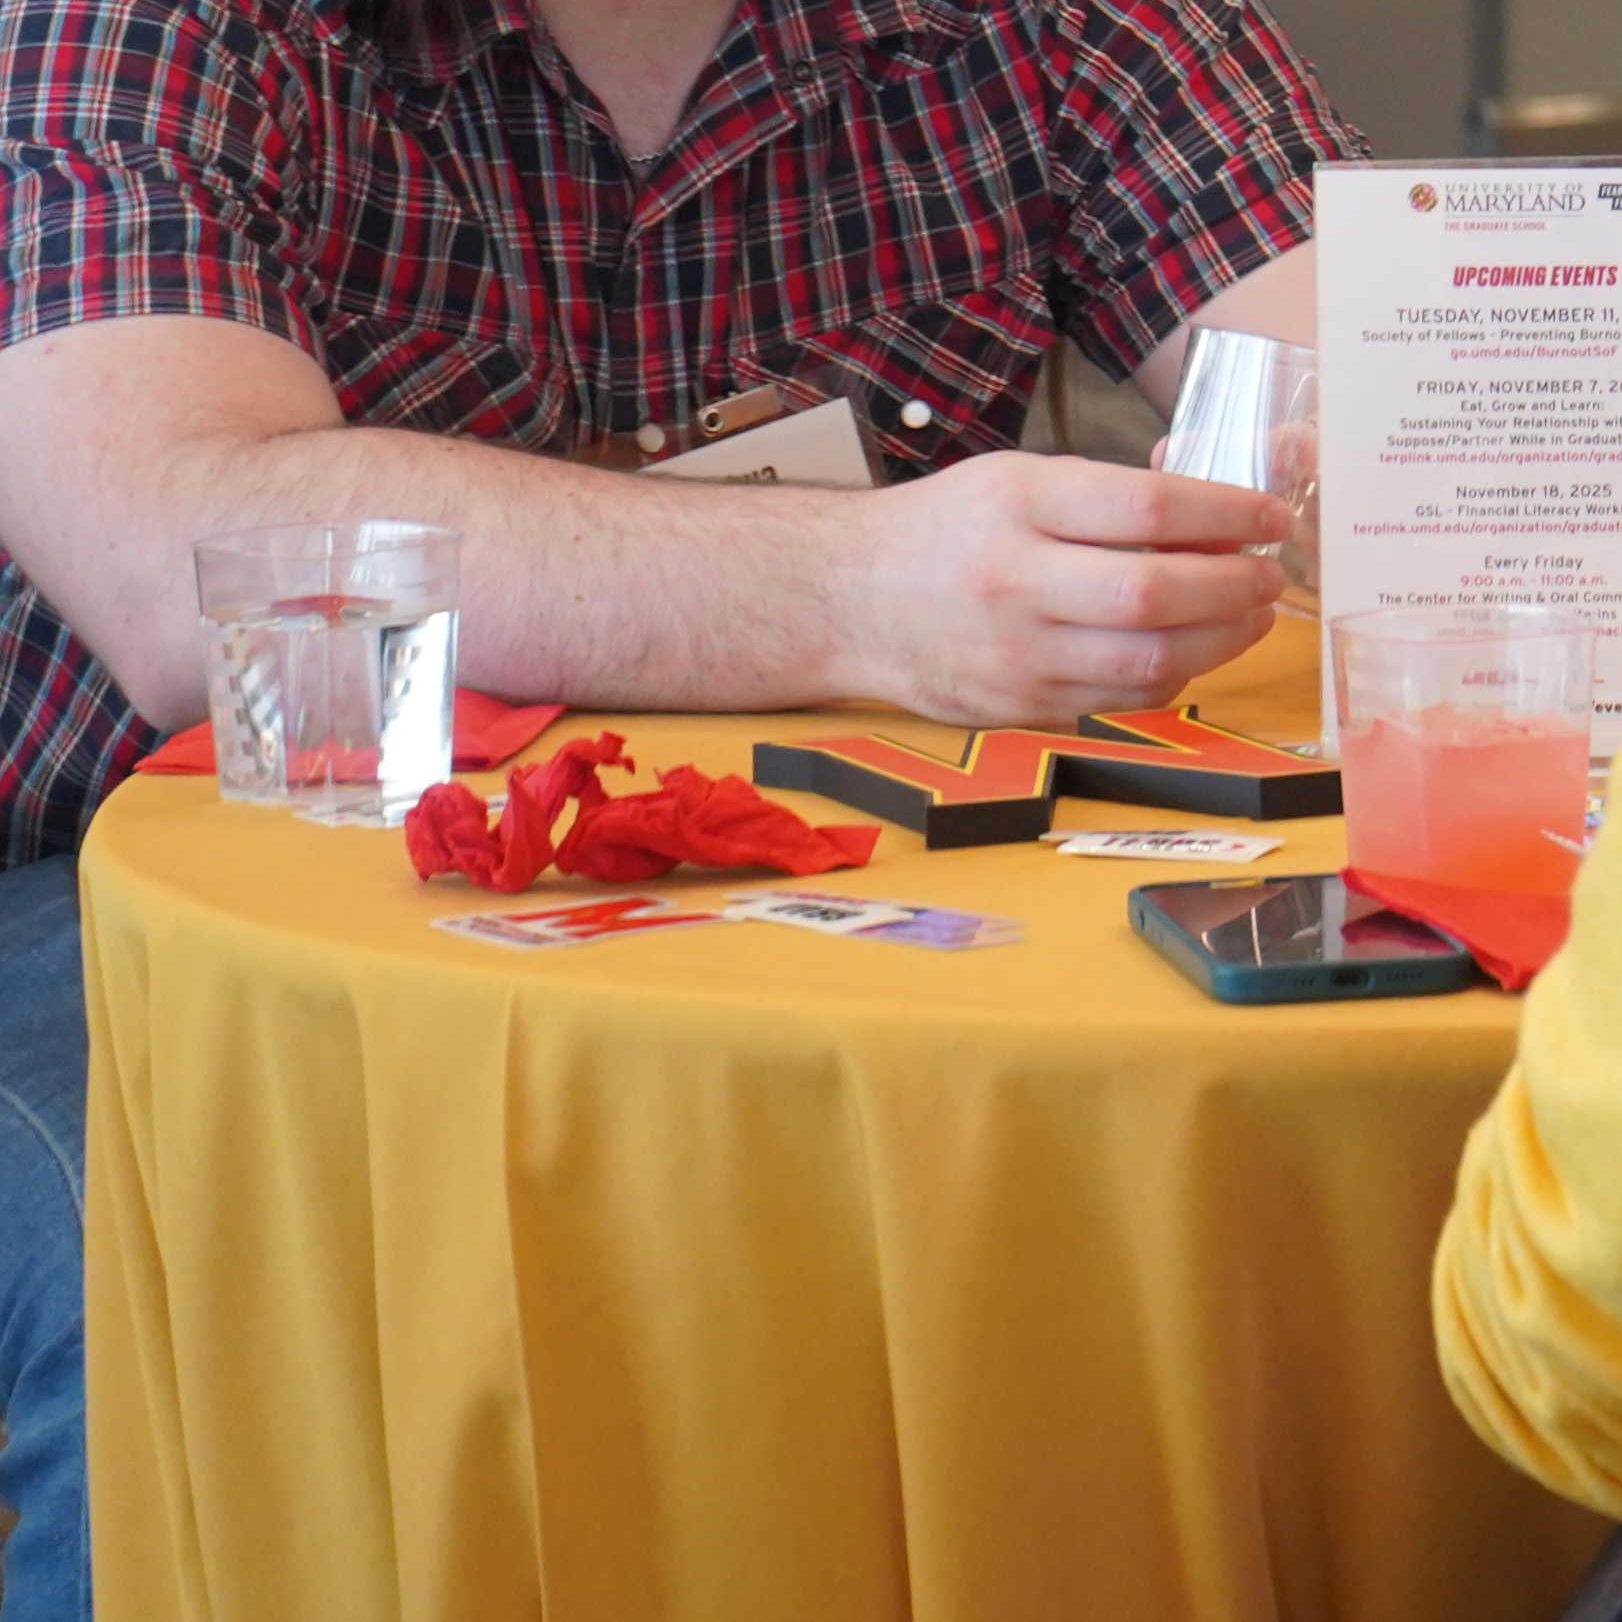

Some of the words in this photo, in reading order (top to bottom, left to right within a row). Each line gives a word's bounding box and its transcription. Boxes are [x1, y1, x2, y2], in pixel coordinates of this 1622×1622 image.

[1445, 184, 1556, 194] UNIVERSITY
[1564, 183, 1584, 193] OF
[1445, 193, 1586, 212] MARYLAND
[1451, 265, 1548, 288] UPCOMING
[1548, 264, 1620, 287] EVENTS
[1395, 308, 1484, 325] TUESDAY,
[1490, 307, 1596, 323] NOVEMBER
[1601, 307, 1620, 324] 11,
[1361, 330, 1414, 344] Society
[1417, 329, 1432, 342] of
[1435, 330, 1486, 341] Fellows
[1500, 328, 1575, 344] Preventing
[1449, 345, 1620, 361] go.umd.edu/BurnoutSoF
[1416, 380, 1484, 396] FRIDAY,
[1488, 379, 1584, 394] NOVEMBER
[1588, 379, 1604, 395] 7,
[1460, 400, 1487, 413] Eat,
[1491, 400, 1527, 412] Grow
[1530, 400, 1557, 411] and
[1560, 400, 1605, 411] Learn:
[1399, 417, 1473, 431] Sustaining
[1477, 417, 1508, 429] Your
[1513, 416, 1600, 430] Relationship
[1386, 434, 1504, 448] Suppose/Partner
[1509, 434, 1547, 445] While
[1550, 435, 1563, 445] in
[1455, 485, 1538, 499] November
[1542, 484, 1565, 500] 18,
[1569, 483, 1613, 498] 2025
[1457, 505, 1520, 516] Financial
[1523, 504, 1581, 518] Literacy
[1484, 555, 1530, 571] Every
[1534, 555, 1584, 571] Friday
[1461, 574, 1494, 587] 9:00
[1498, 576, 1526, 587] a.m.
[1540, 575, 1575, 586] 11:00
[1578, 576, 1607, 586] a.m.
[1377, 592, 1403, 605] The
[1406, 592, 1453, 605] Center
[1457, 592, 1477, 604] for
[1535, 591, 1546, 603] &
[1550, 592, 1579, 603] Oral
